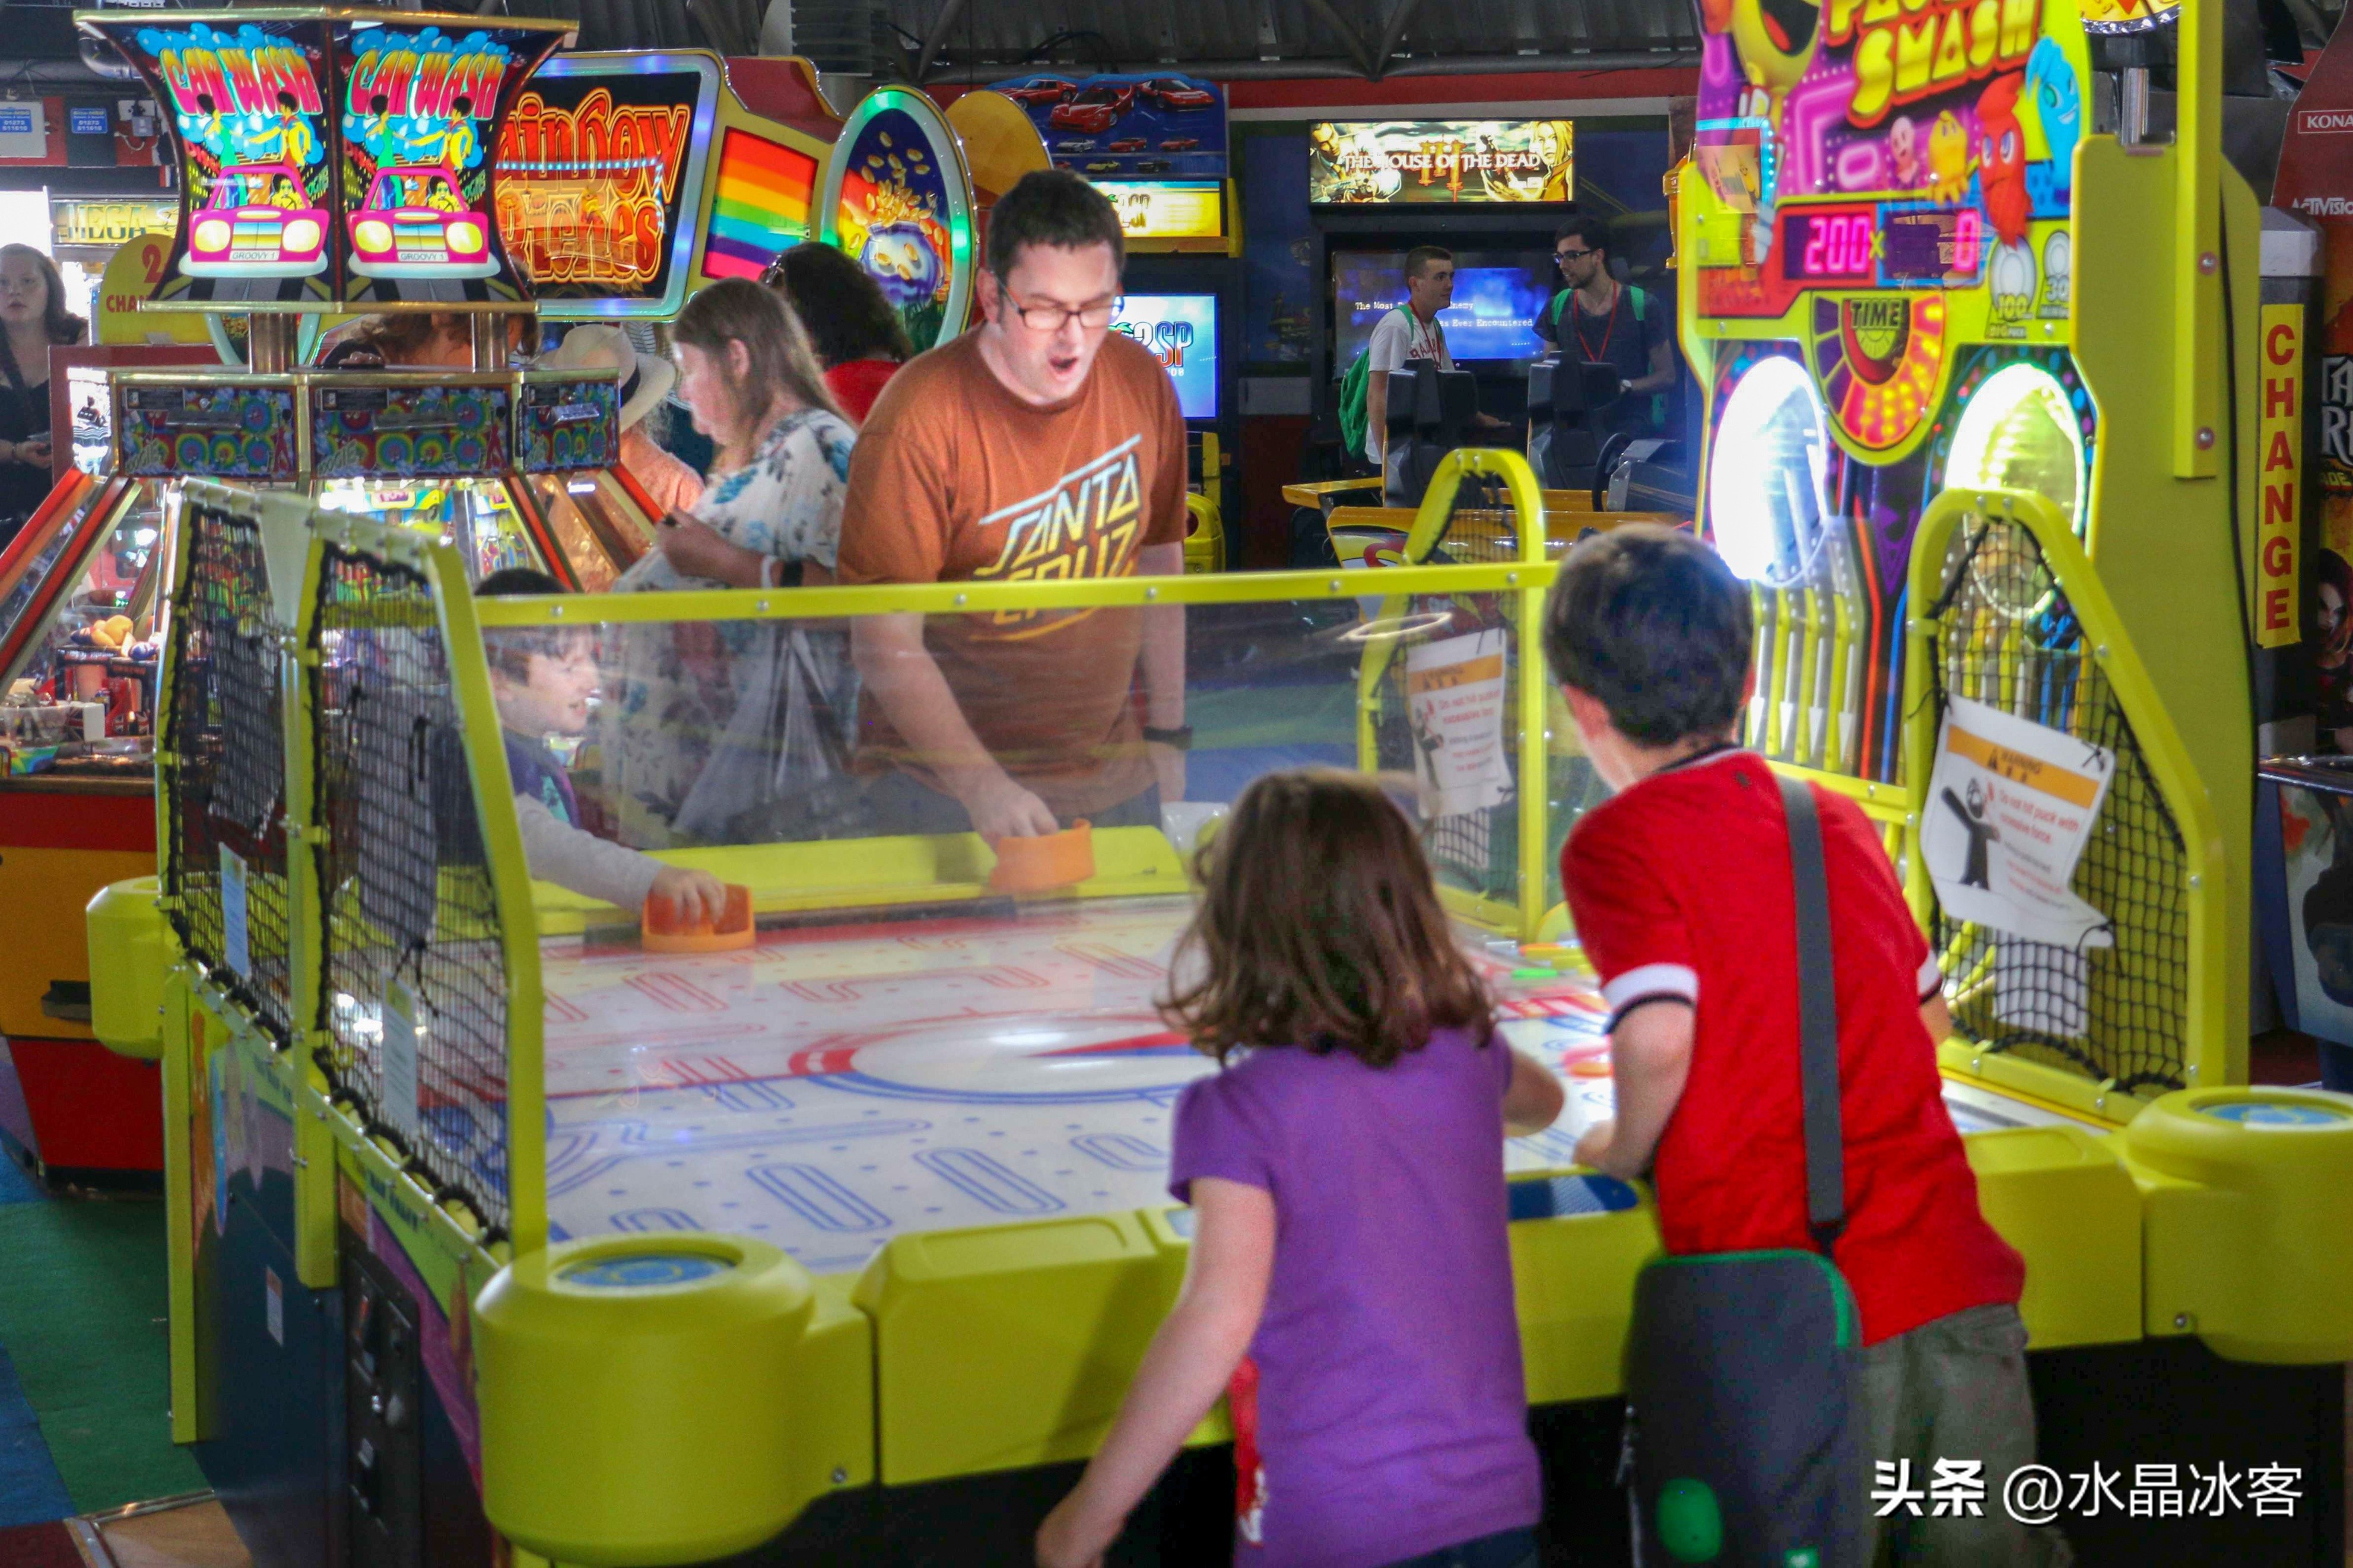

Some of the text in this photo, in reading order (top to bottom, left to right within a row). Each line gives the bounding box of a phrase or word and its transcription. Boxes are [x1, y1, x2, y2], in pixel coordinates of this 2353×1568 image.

[1852, 0, 2036, 115] SMASH
[159, 45, 323, 119] CAR WASH
[344, 49, 508, 121] CAR WASH
[495, 88, 691, 205] ainbow
[1344, 152, 1371, 171] THE
[1436, 154, 1458, 170] OF
[1461, 152, 1494, 173] THE
[1495, 153, 1541, 170] DEAD
[67, 204, 148, 240] MEGA
[232, 251, 268, 260] GROOVY
[401, 253, 438, 261] GROOVY
[1805, 214, 1870, 273] 200
[1953, 208, 1982, 272] 0
[142, 243, 162, 284] 2
[106, 294, 146, 313] CHA
[1355, 301, 1370, 310] The
[1374, 301, 1393, 310] Most
[1850, 299, 1901, 327] TIME
[1998, 292, 2028, 320] 100
[1476, 318, 1533, 327] Encountered
[2262, 323, 2295, 631] CHANGE
[973, 452, 1141, 576] SANTA
